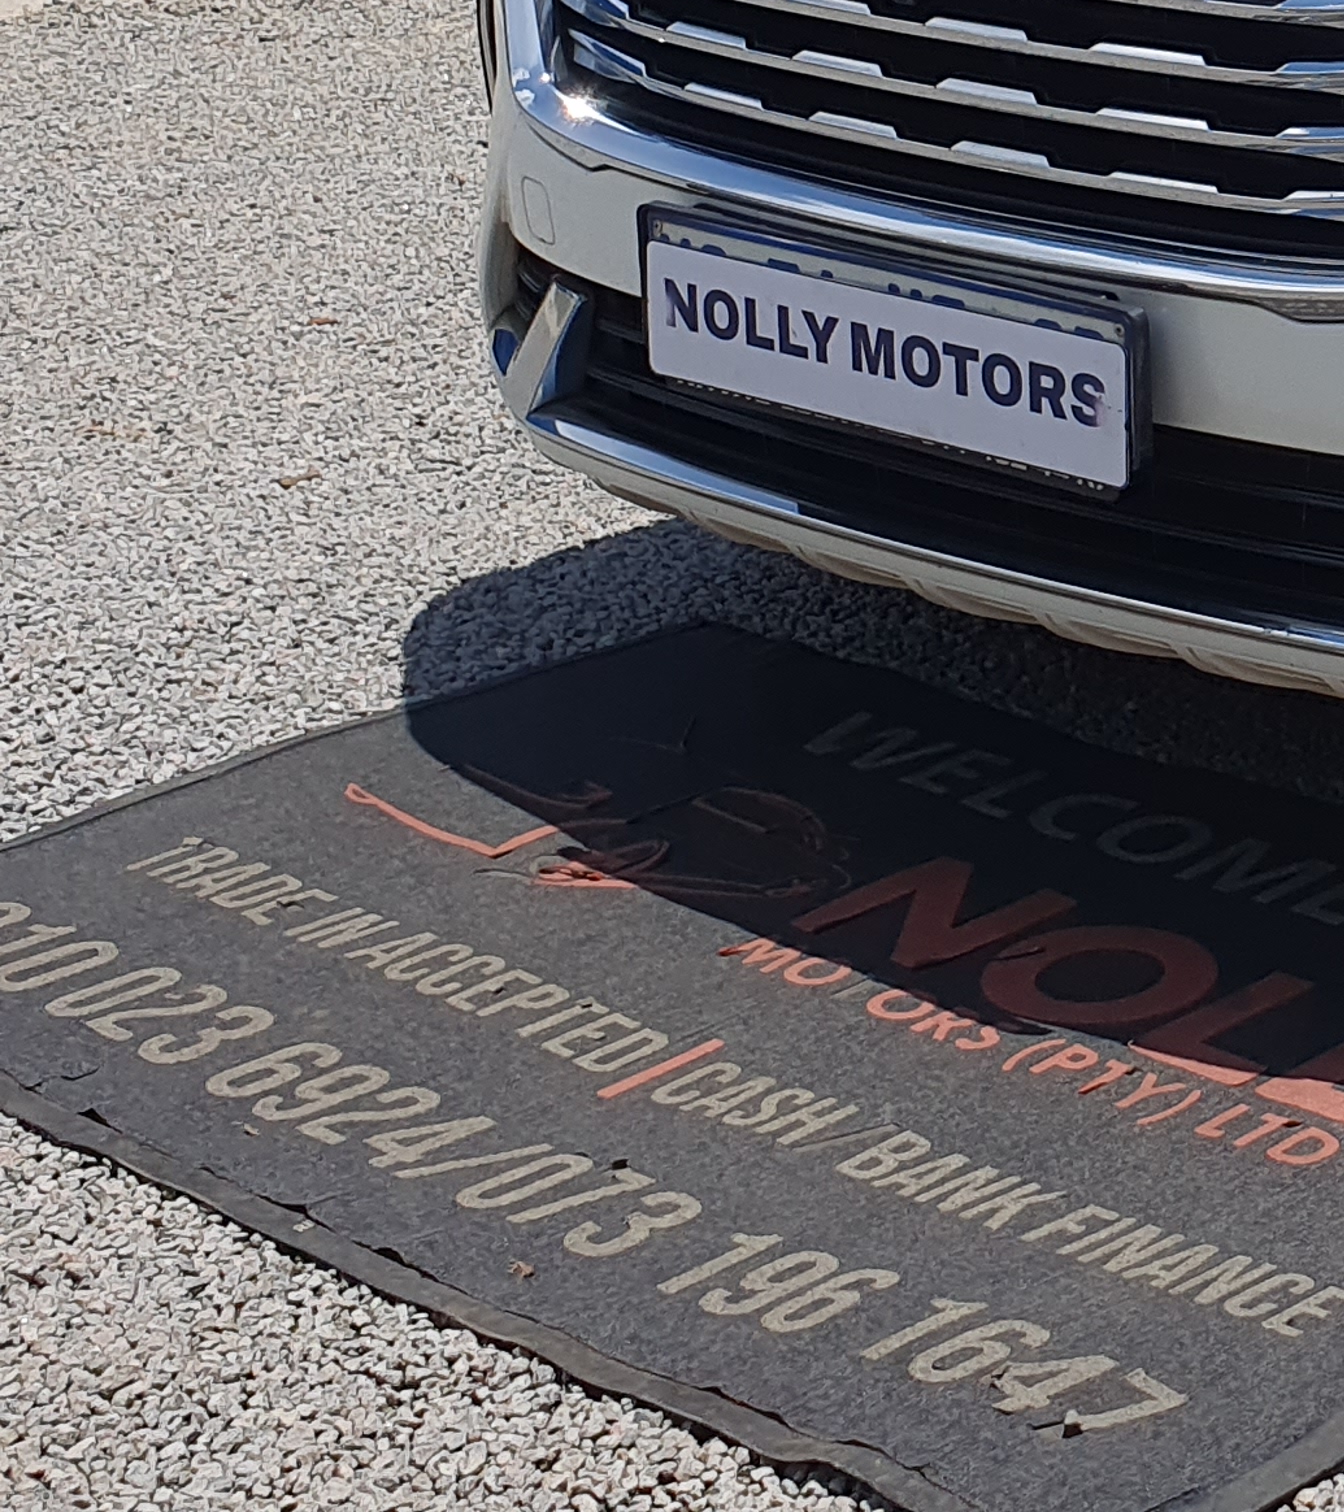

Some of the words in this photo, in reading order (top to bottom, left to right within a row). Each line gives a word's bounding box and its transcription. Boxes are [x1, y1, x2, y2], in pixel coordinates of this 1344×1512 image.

[662, 277, 840, 365] NOLLY
[850, 321, 1106, 429] MOTORS
[126, 836, 340, 926] TRADE
[283, 906, 400, 949] IN
[343, 931, 669, 1073] ACCEPTED
[0, 901, 119, 992] 10
[657, 1232, 900, 1333] 196
[862, 1296, 1191, 1439] 1647
[1002, 1038, 1202, 1128] (PTY)
[1193, 1103, 1341, 1166] LTD
